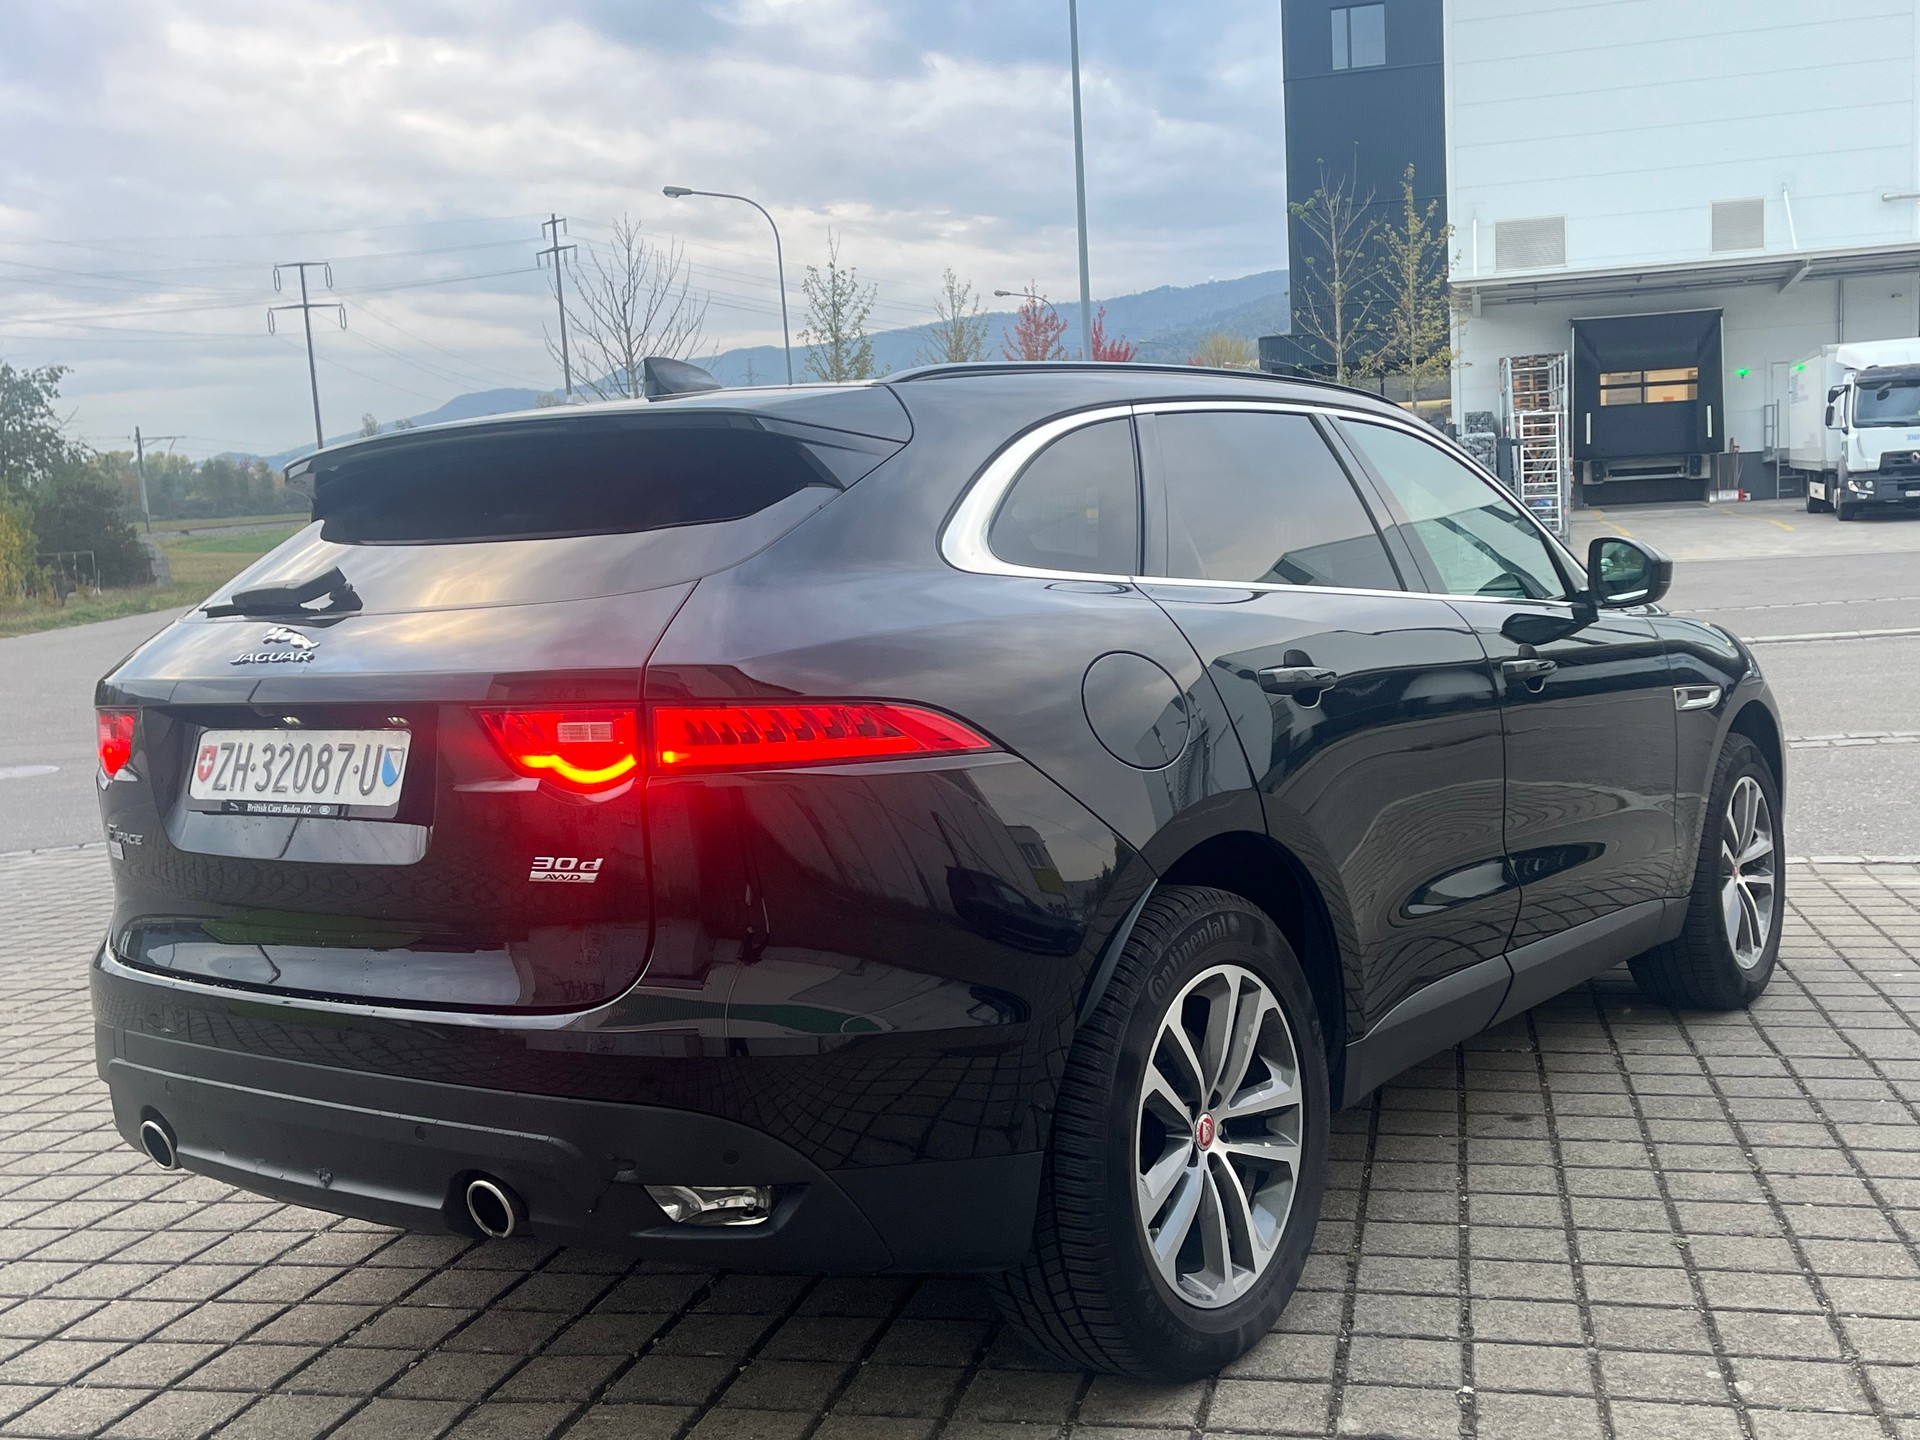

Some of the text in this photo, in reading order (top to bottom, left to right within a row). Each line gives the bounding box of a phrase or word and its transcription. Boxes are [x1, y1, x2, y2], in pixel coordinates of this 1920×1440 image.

[230, 651, 314, 664] JAGUAR
[247, 803, 267, 812] British
[268, 804, 281, 813] Cars
[301, 805, 312, 814] AG
[543, 873, 581, 881] AWD
[1149, 913, 1228, 1004] Continental
